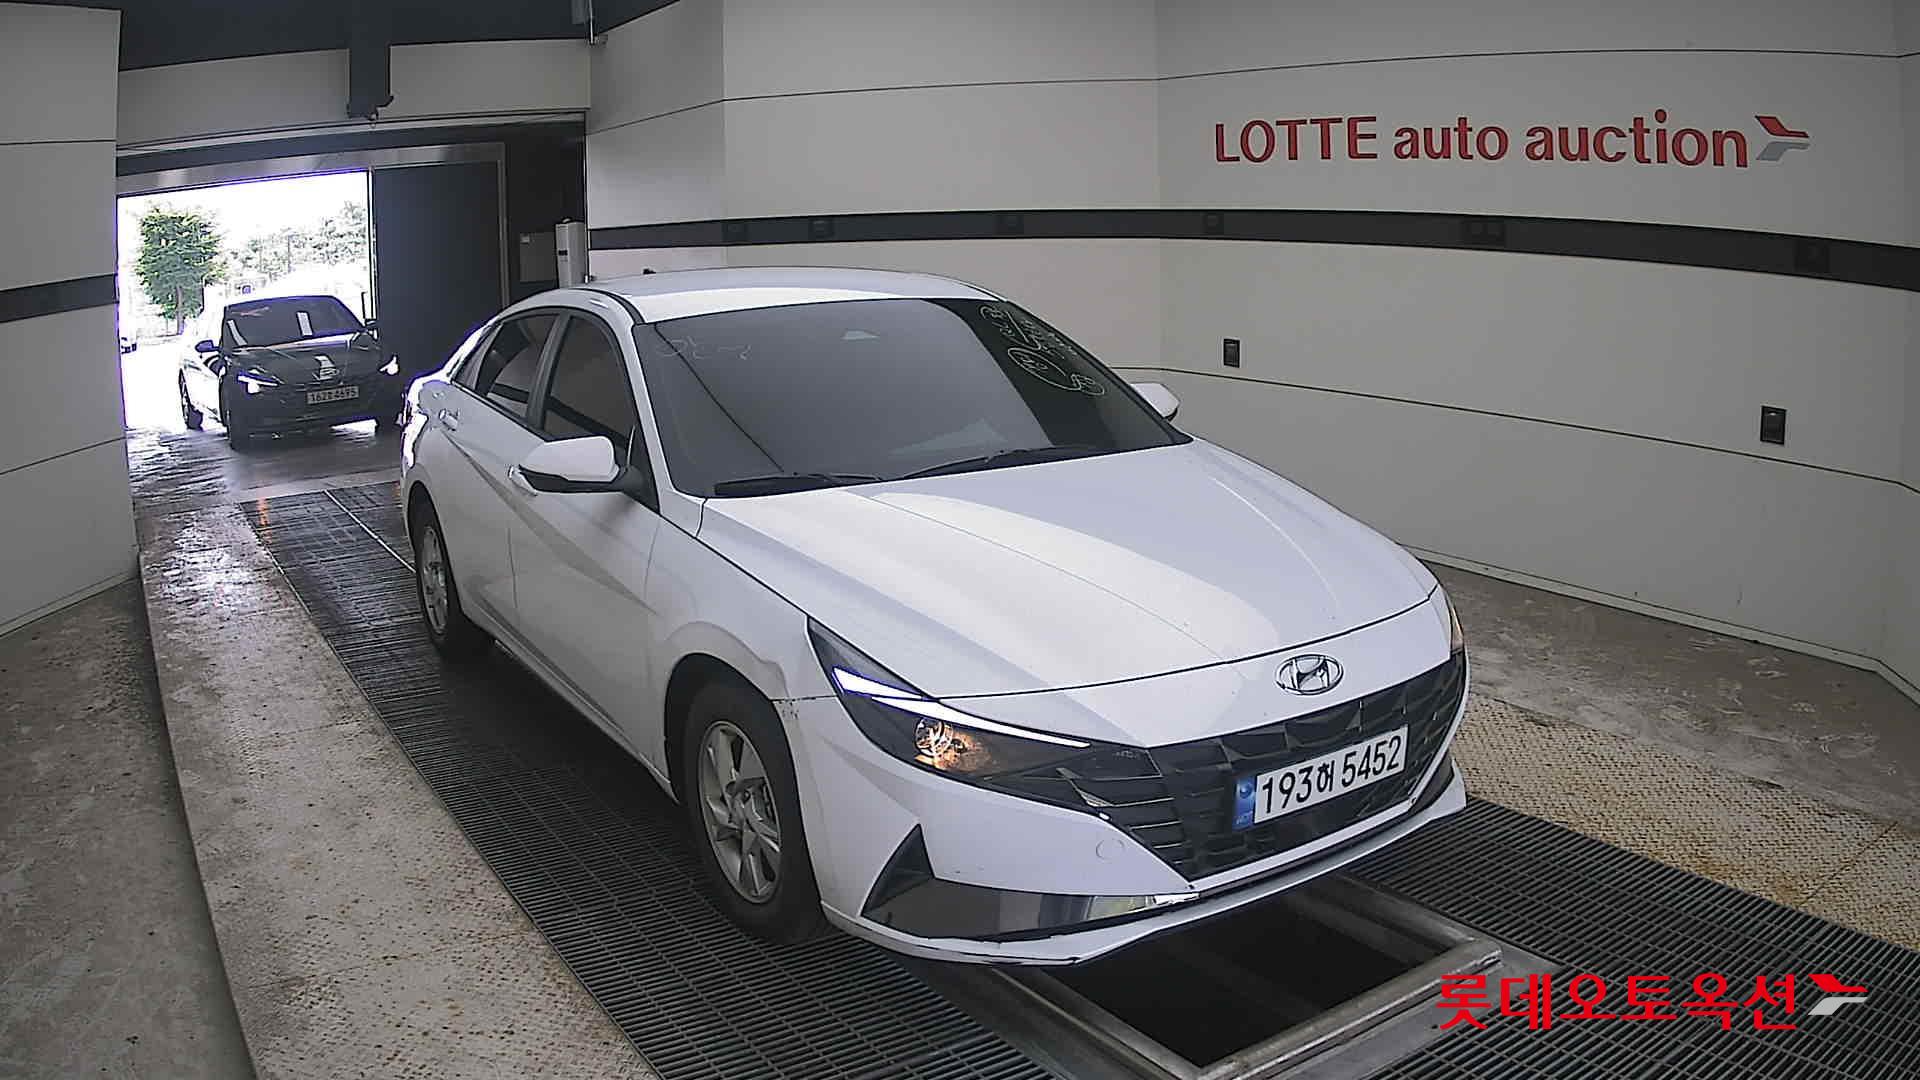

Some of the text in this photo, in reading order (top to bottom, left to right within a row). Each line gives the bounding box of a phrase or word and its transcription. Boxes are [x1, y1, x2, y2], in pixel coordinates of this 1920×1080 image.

[1214, 108, 1749, 169] LOTTE auto auction
[1262, 735, 1402, 814] 193허 5452
